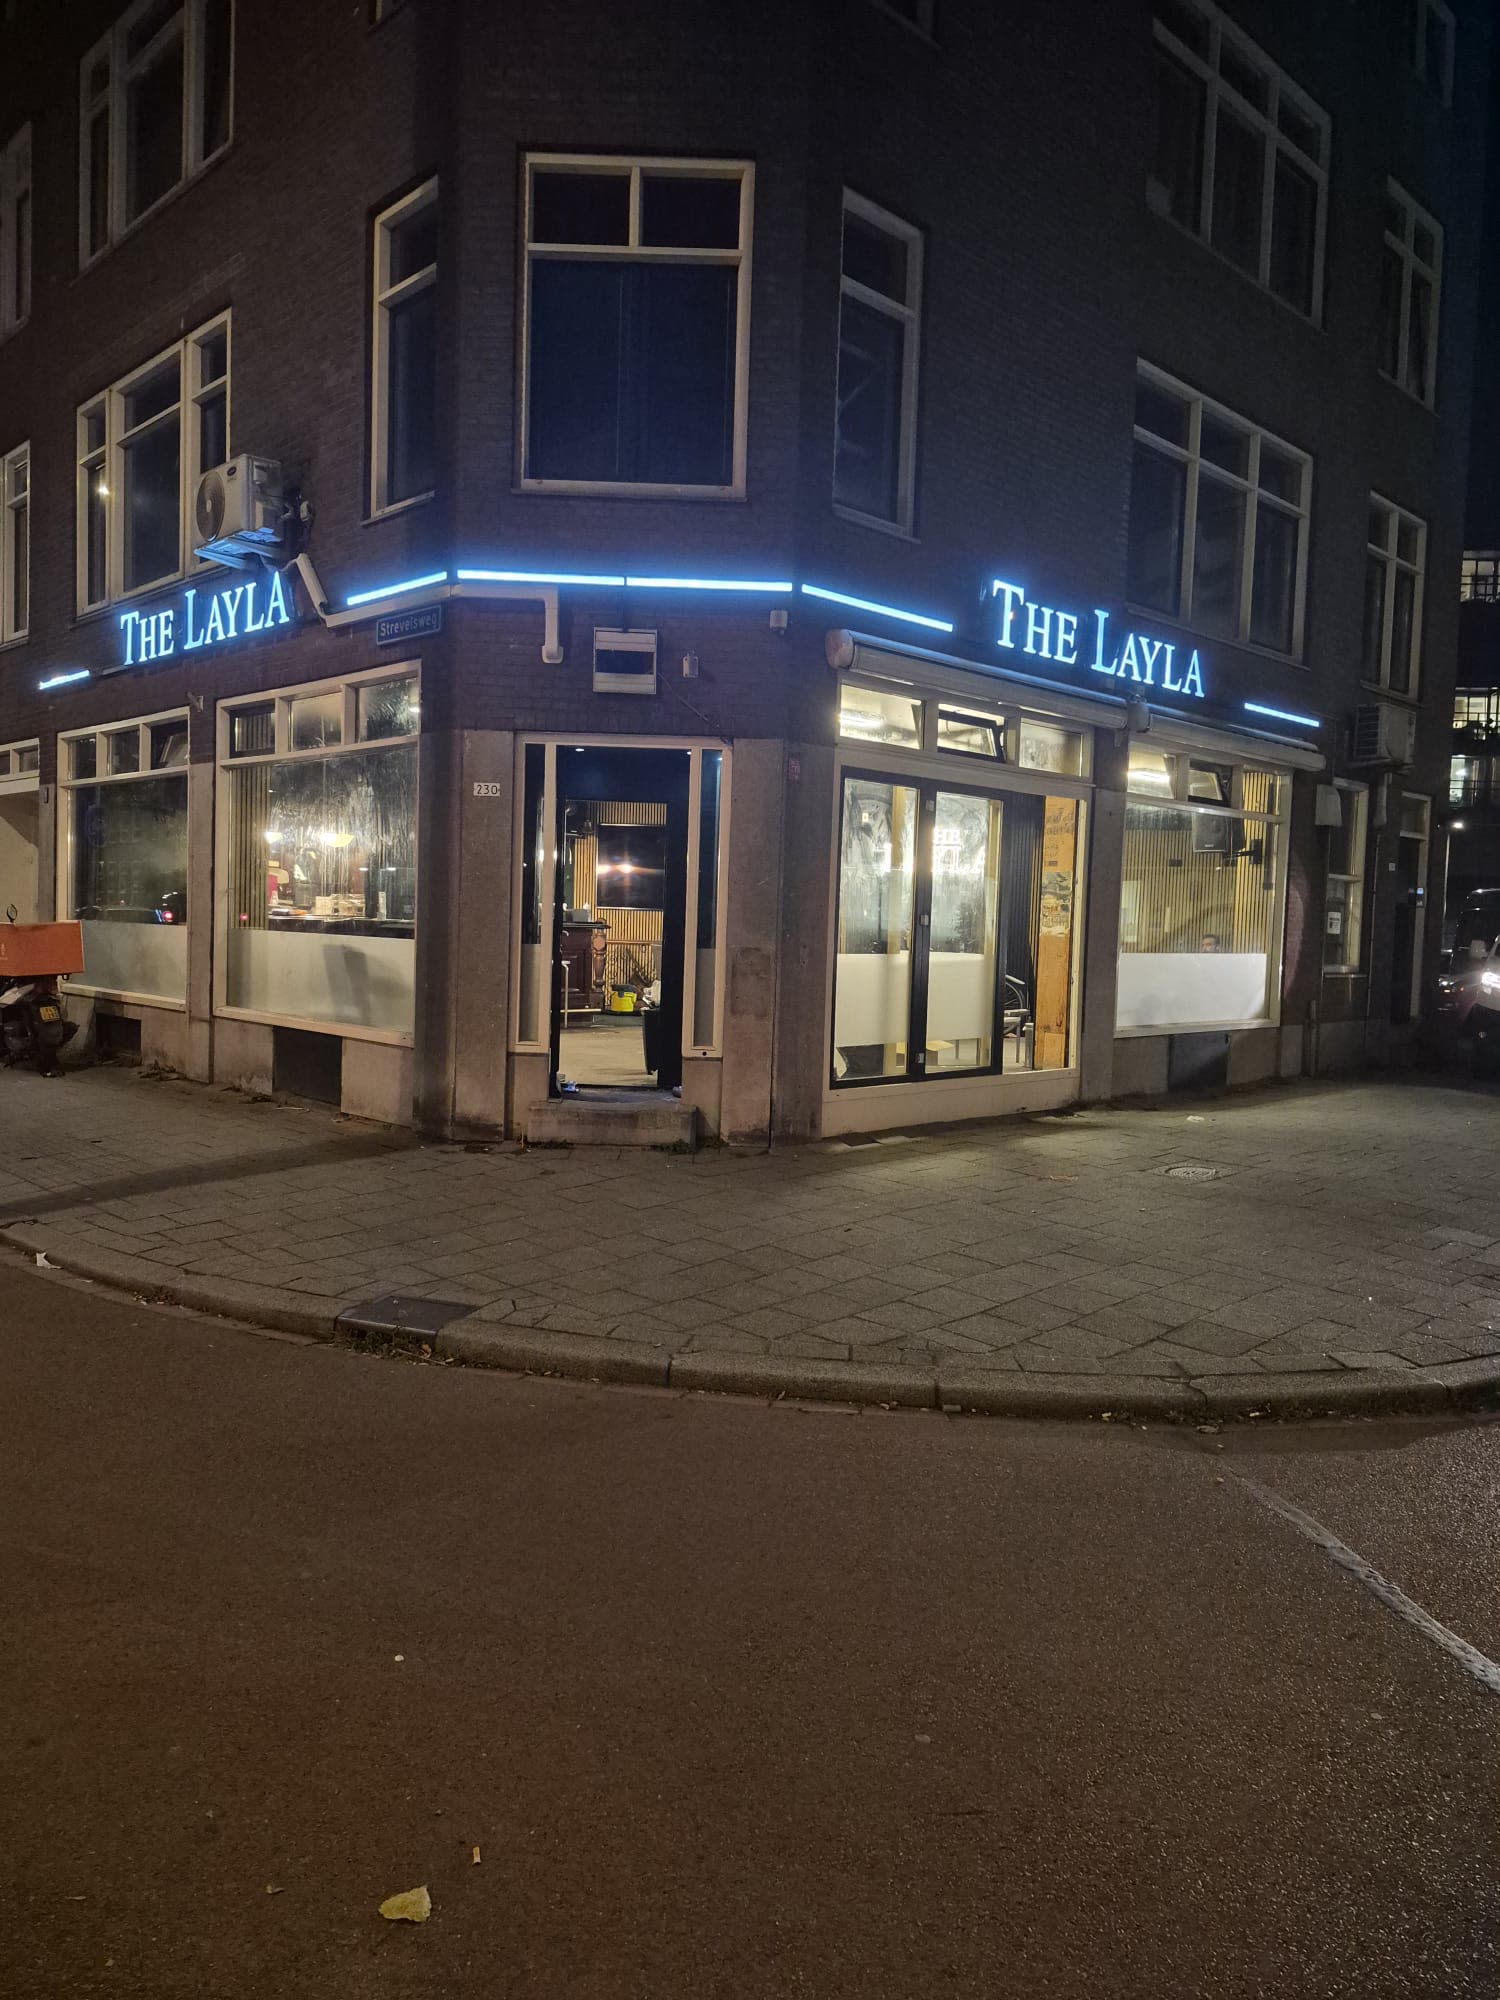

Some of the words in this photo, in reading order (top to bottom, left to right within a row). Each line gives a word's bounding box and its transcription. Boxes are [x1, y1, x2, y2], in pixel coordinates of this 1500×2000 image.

[119, 609, 175, 666] THE
[183, 570, 290, 650] LAYLA
[992, 578, 1079, 665] THE
[1090, 609, 1205, 698] LAYLA
[476, 784, 498, 795] 230
